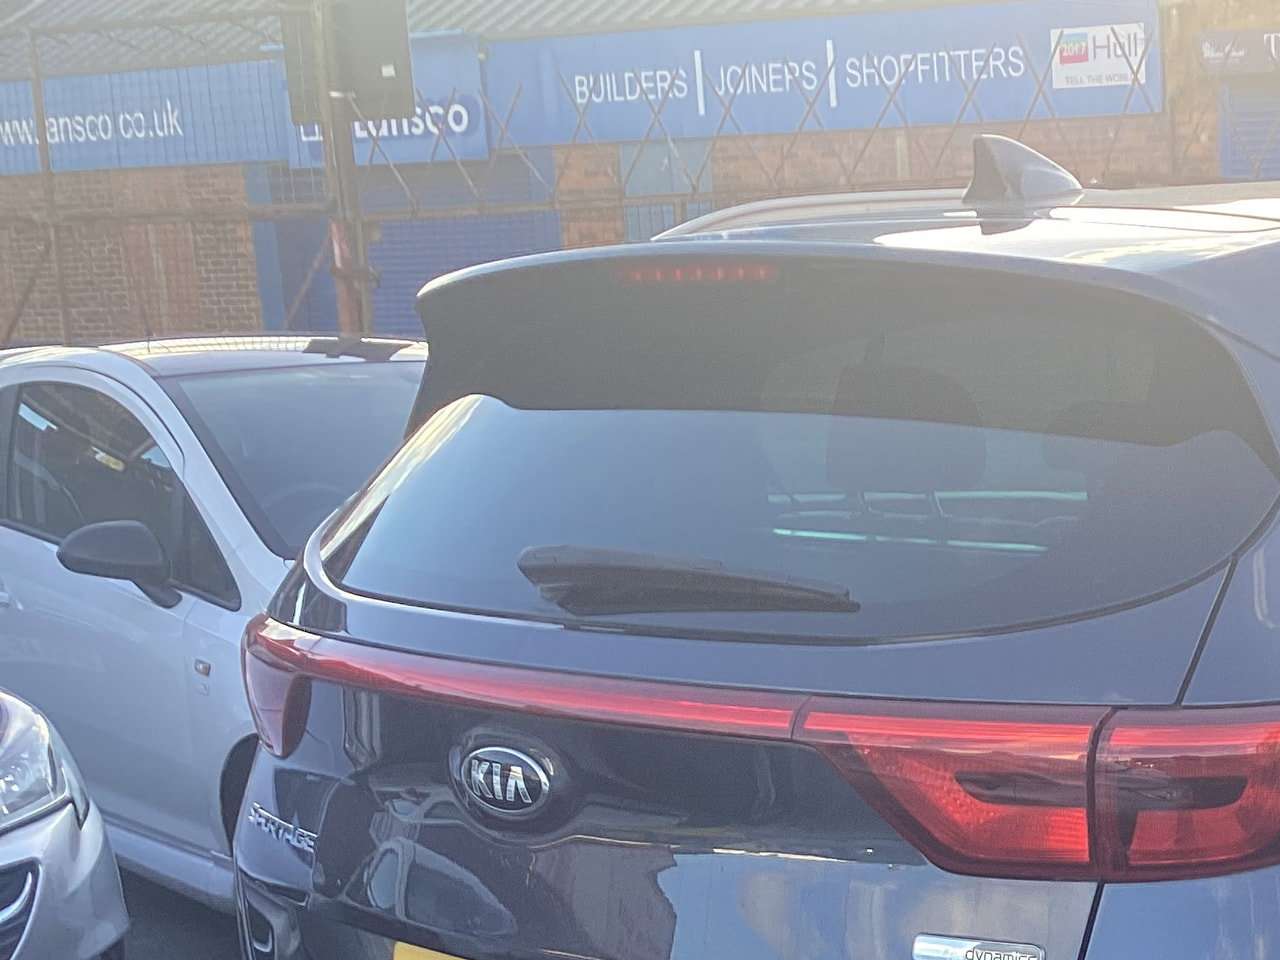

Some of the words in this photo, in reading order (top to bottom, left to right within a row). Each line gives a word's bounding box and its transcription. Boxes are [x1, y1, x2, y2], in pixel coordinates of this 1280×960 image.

[574, 67, 688, 104] BUILDERS
[715, 60, 817, 96] JOINERS
[845, 46, 1024, 88] SHOPFITTERS
[471, 759, 532, 803] KIA
